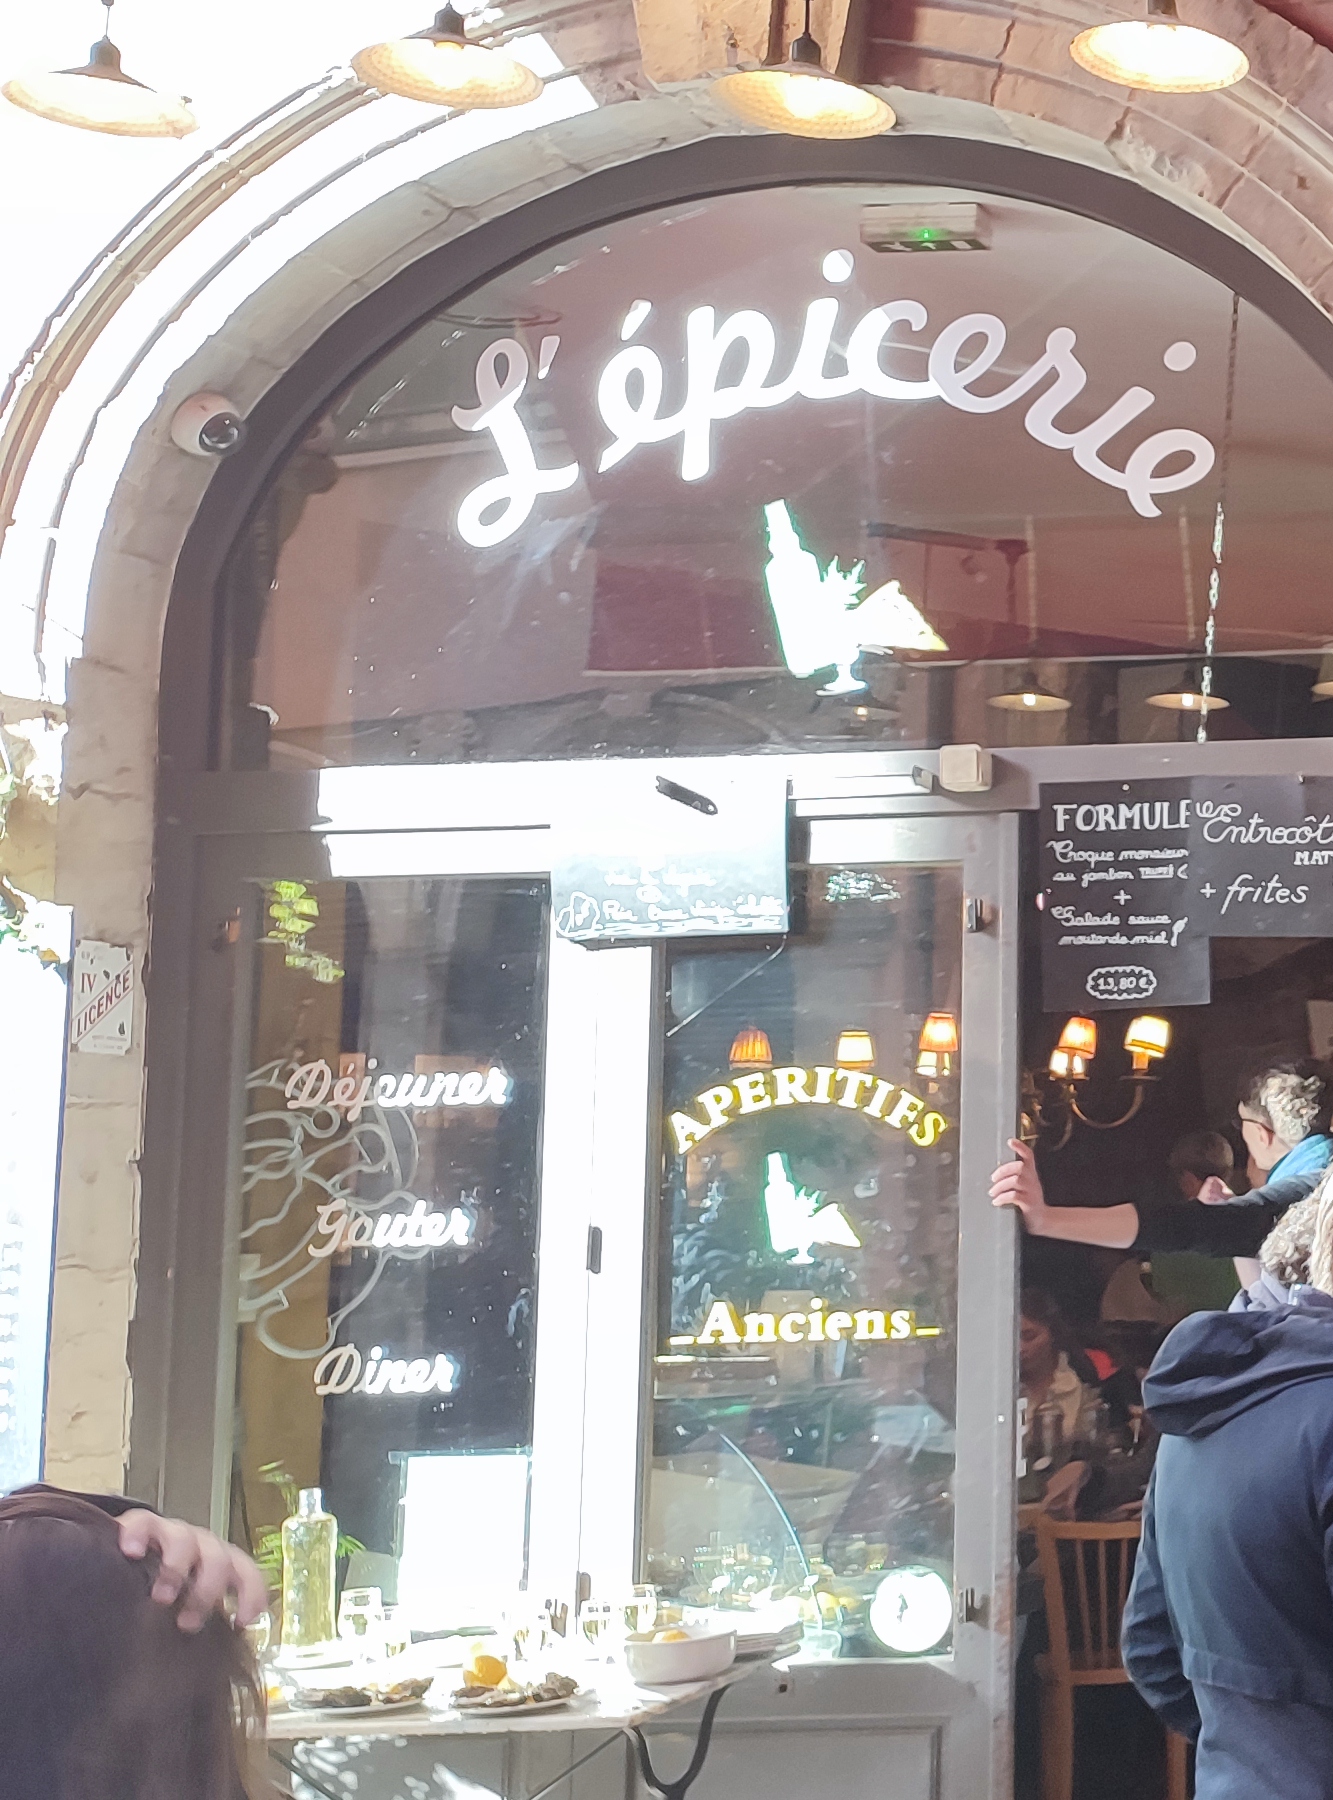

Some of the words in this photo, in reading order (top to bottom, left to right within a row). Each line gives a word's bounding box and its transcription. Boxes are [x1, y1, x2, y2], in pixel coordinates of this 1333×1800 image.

[451, 248, 1216, 549] L'épicerie
[1053, 800, 1192, 833] FORMULE
[1046, 840, 1116, 869] Croque
[1220, 873, 1310, 915] frites
[76, 969, 131, 1038] LICENCE
[81, 972, 97, 994] IV
[285, 1057, 511, 1123] Déjeuner
[668, 1065, 949, 1156] APERITIFS
[696, 1297, 914, 1344] Anciens
[313, 1342, 457, 1396] Diner
